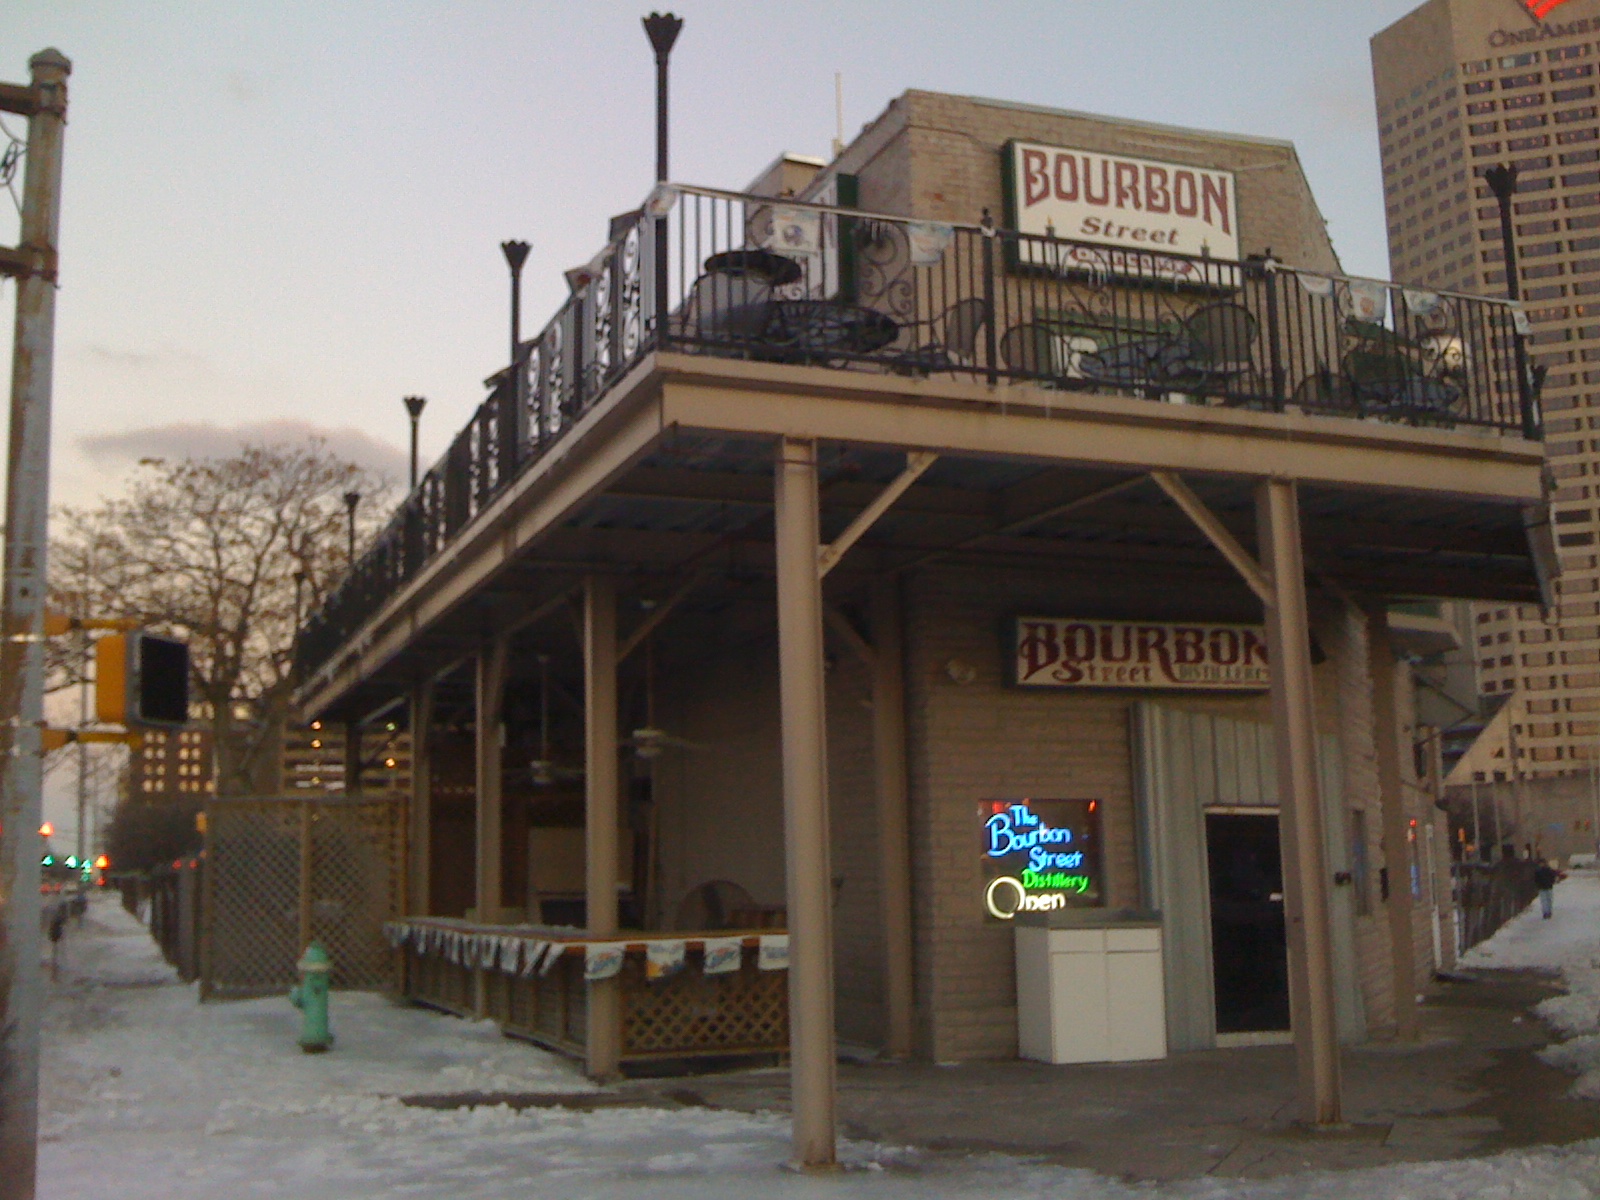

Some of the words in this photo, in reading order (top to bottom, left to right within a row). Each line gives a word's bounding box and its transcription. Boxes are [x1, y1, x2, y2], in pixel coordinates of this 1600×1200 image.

[1022, 149, 1232, 237] BOURBON
[1080, 216, 1179, 245] Street
[1052, 659, 1151, 683] Street
[1009, 804, 1039, 827] The
[985, 812, 1073, 857] Bourbon
[1028, 846, 1083, 872] Street
[1022, 868, 1088, 894] Distillery
